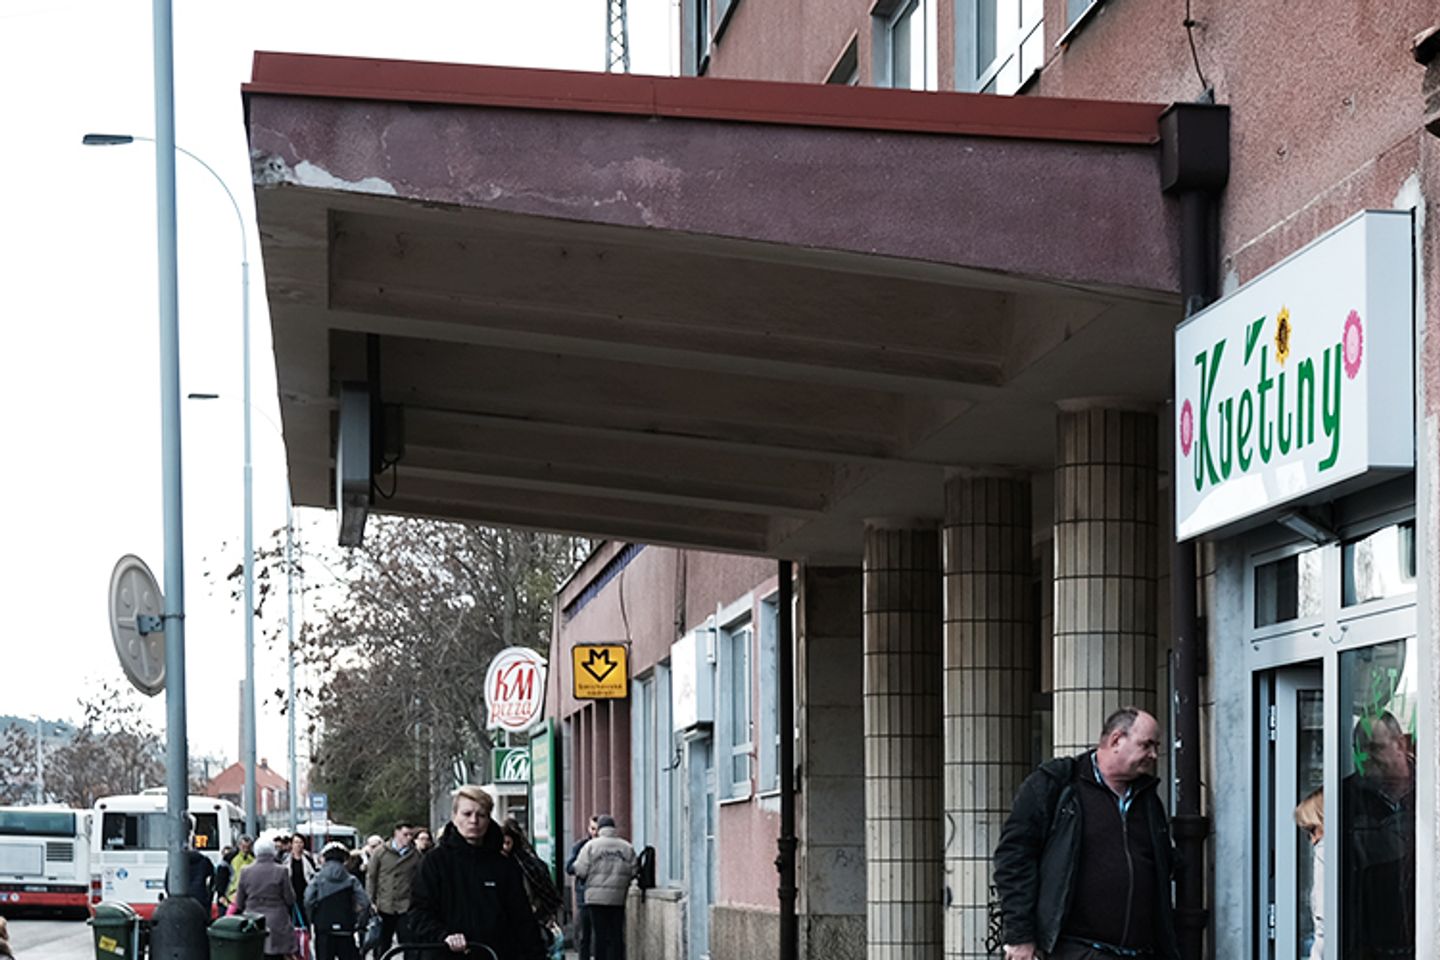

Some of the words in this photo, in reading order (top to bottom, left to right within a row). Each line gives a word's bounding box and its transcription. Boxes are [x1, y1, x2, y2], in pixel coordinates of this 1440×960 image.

[1194, 315, 1342, 492] Květiny
[494, 662, 535, 702] KM
[490, 702, 531, 723] pizza
